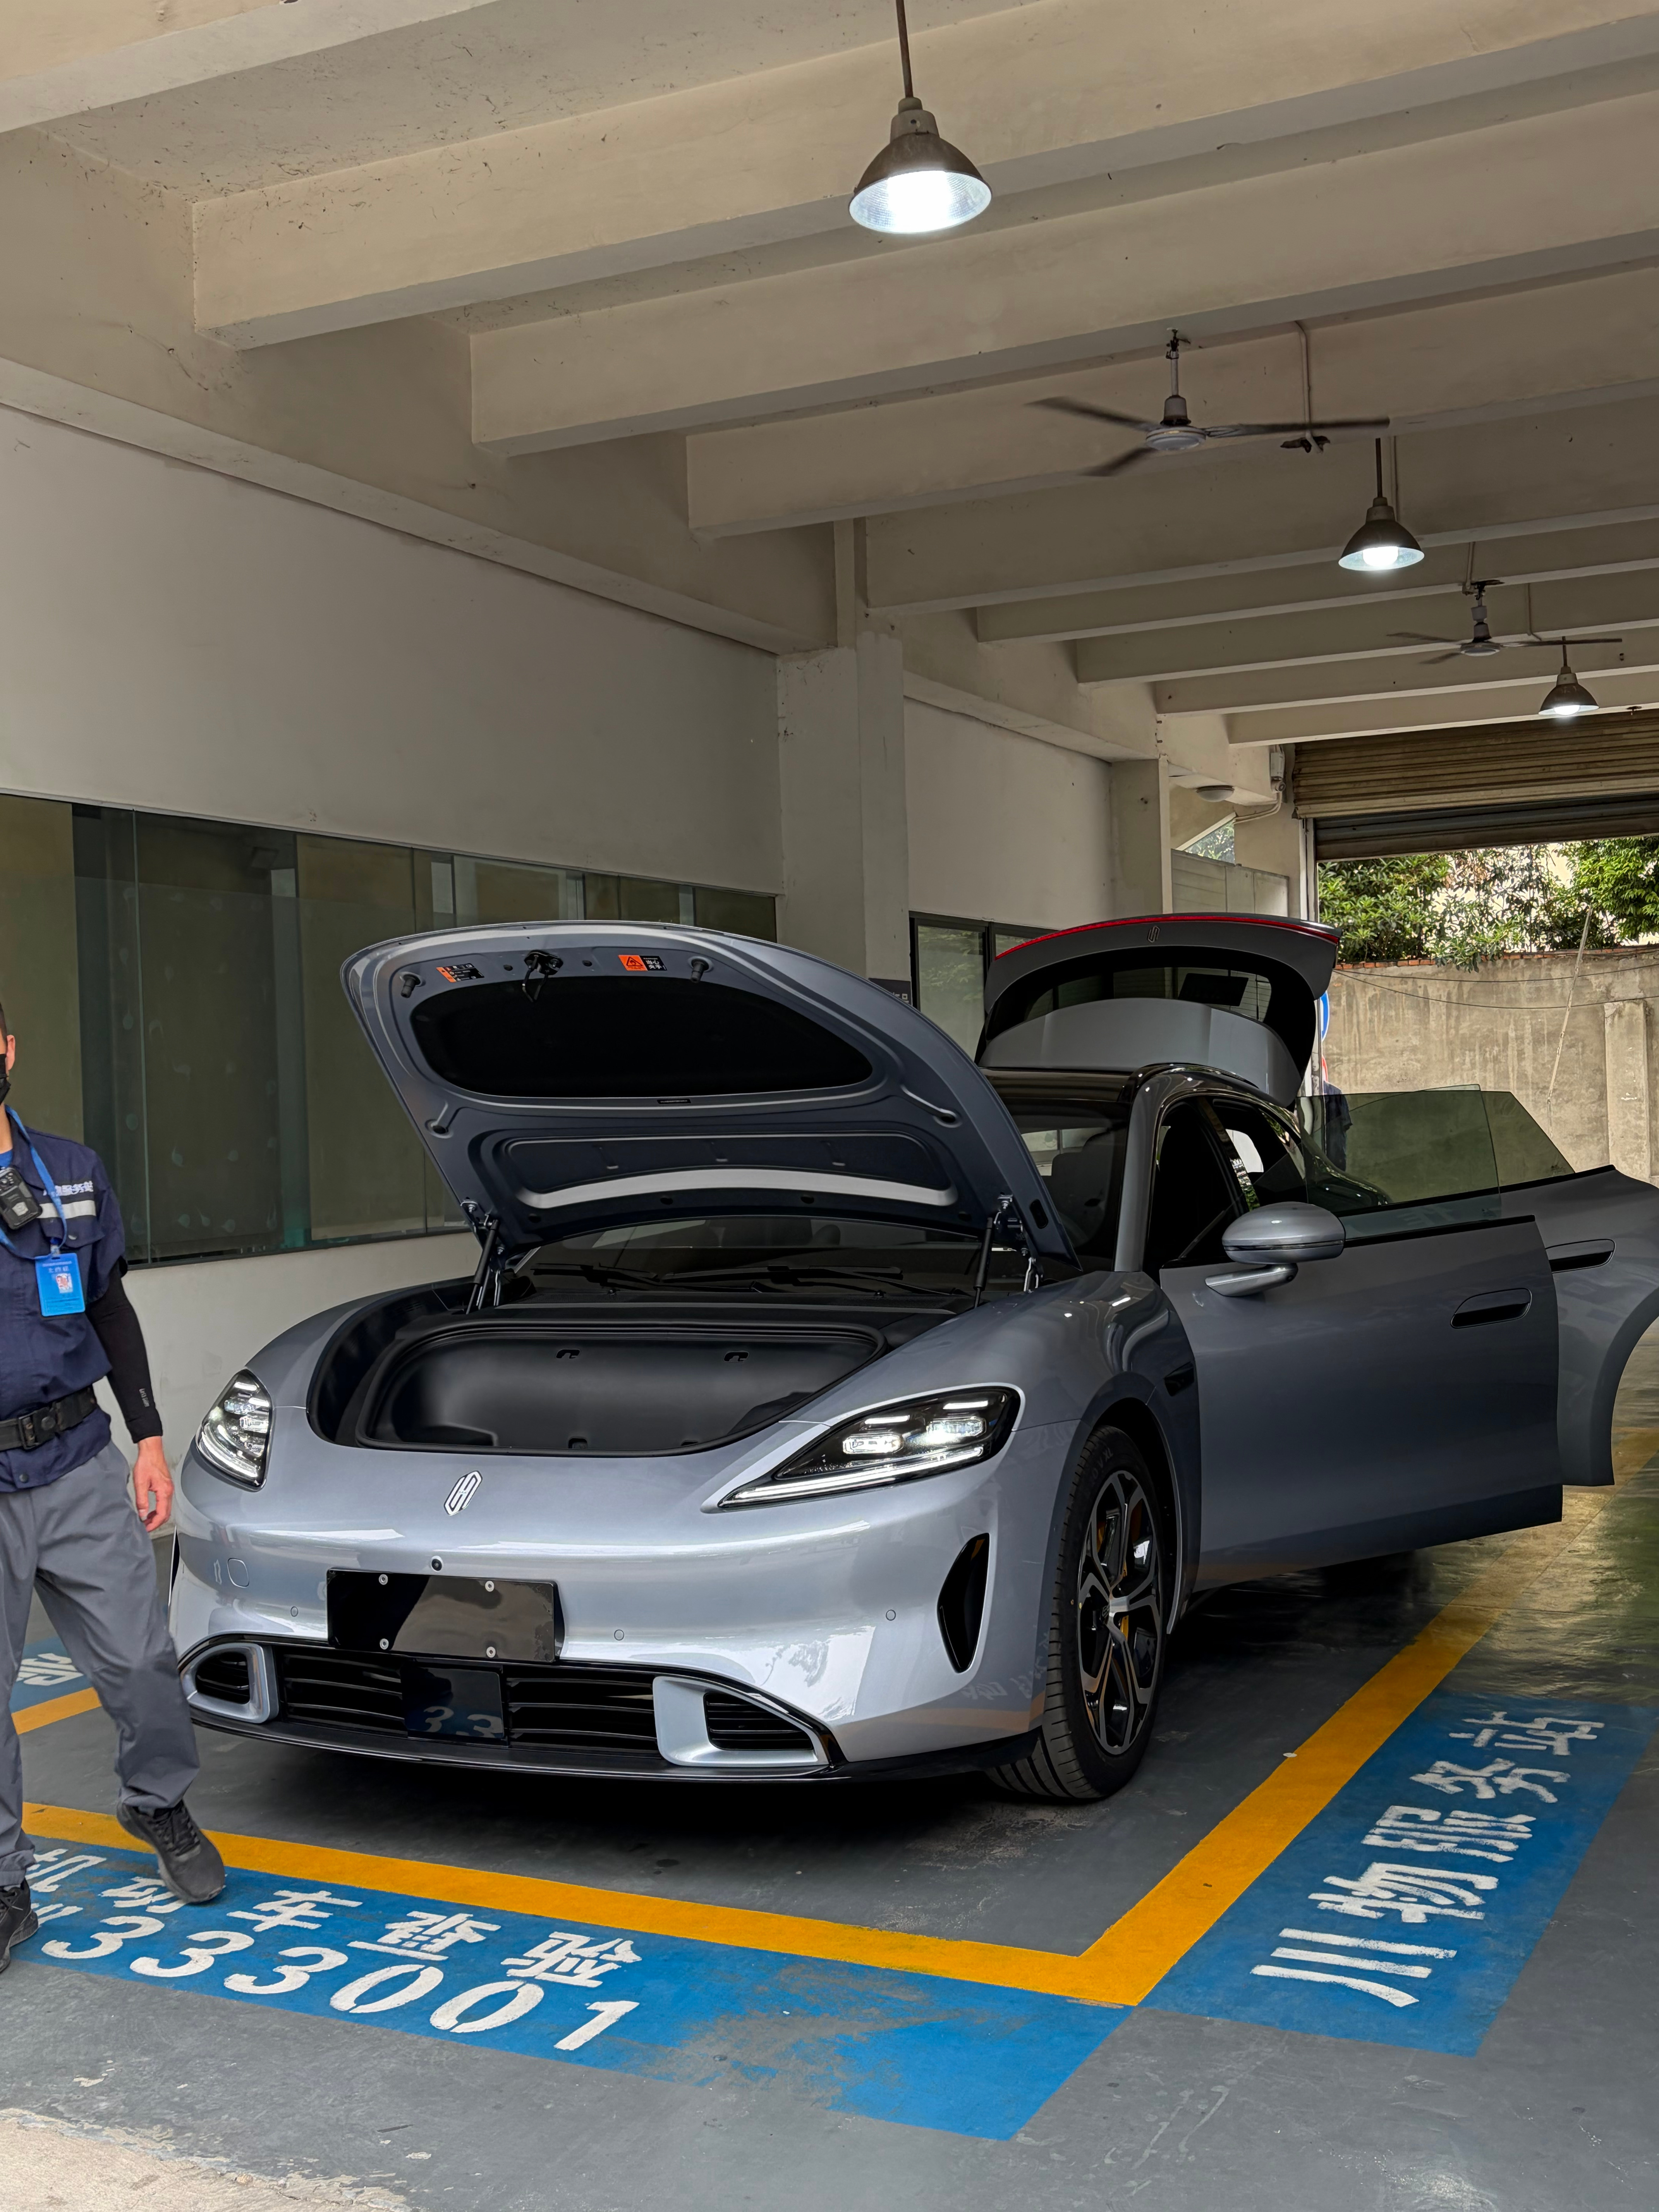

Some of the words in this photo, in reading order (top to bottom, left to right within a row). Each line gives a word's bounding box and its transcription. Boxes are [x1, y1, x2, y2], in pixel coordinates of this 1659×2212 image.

[1250, 1711, 1605, 2008] 川物服务站
